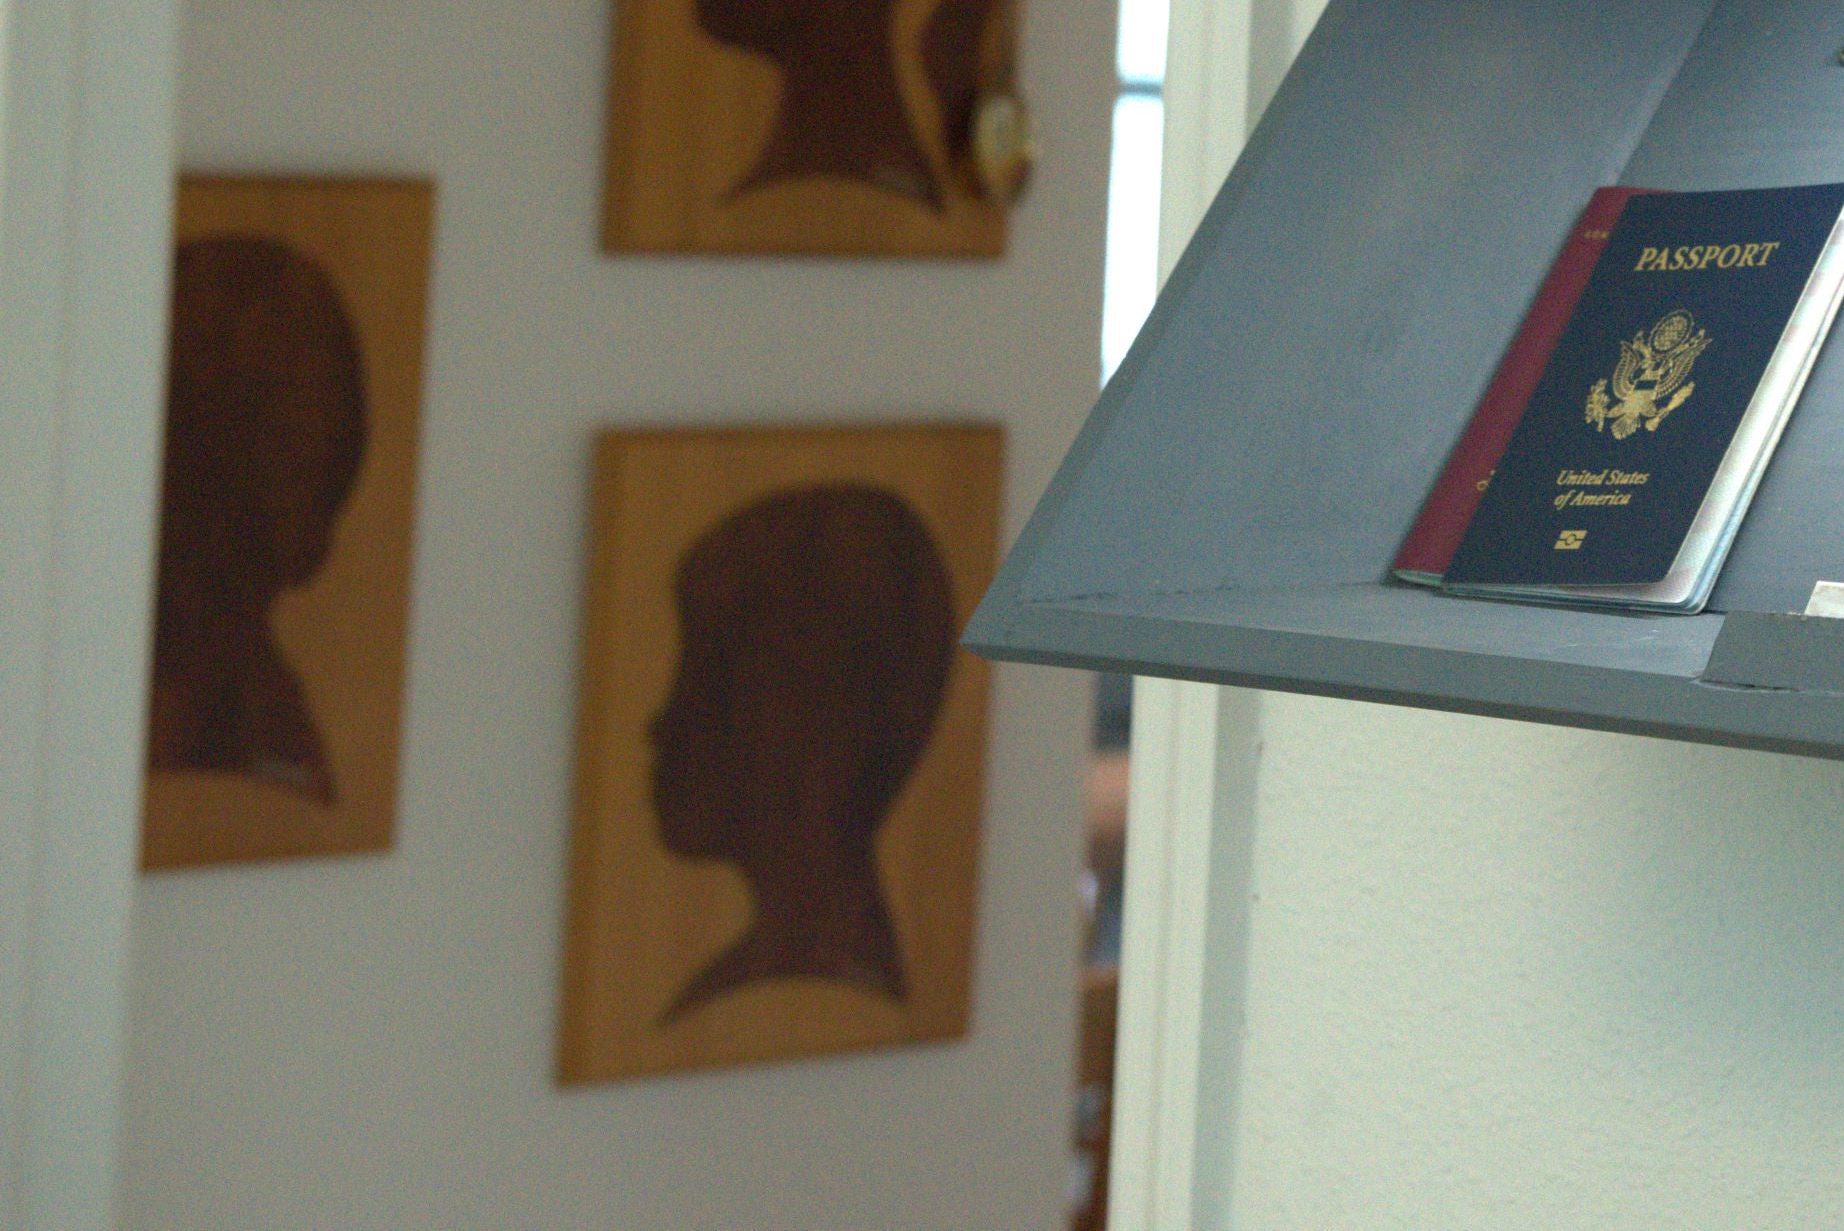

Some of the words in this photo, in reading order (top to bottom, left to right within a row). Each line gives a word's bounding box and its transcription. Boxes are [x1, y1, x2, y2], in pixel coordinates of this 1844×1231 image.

[1634, 242, 1780, 271] PASSPORT
[1556, 469, 1609, 485] United
[1606, 470, 1650, 485] States
[1553, 489, 1576, 510] of
[1569, 490, 1631, 506] America
